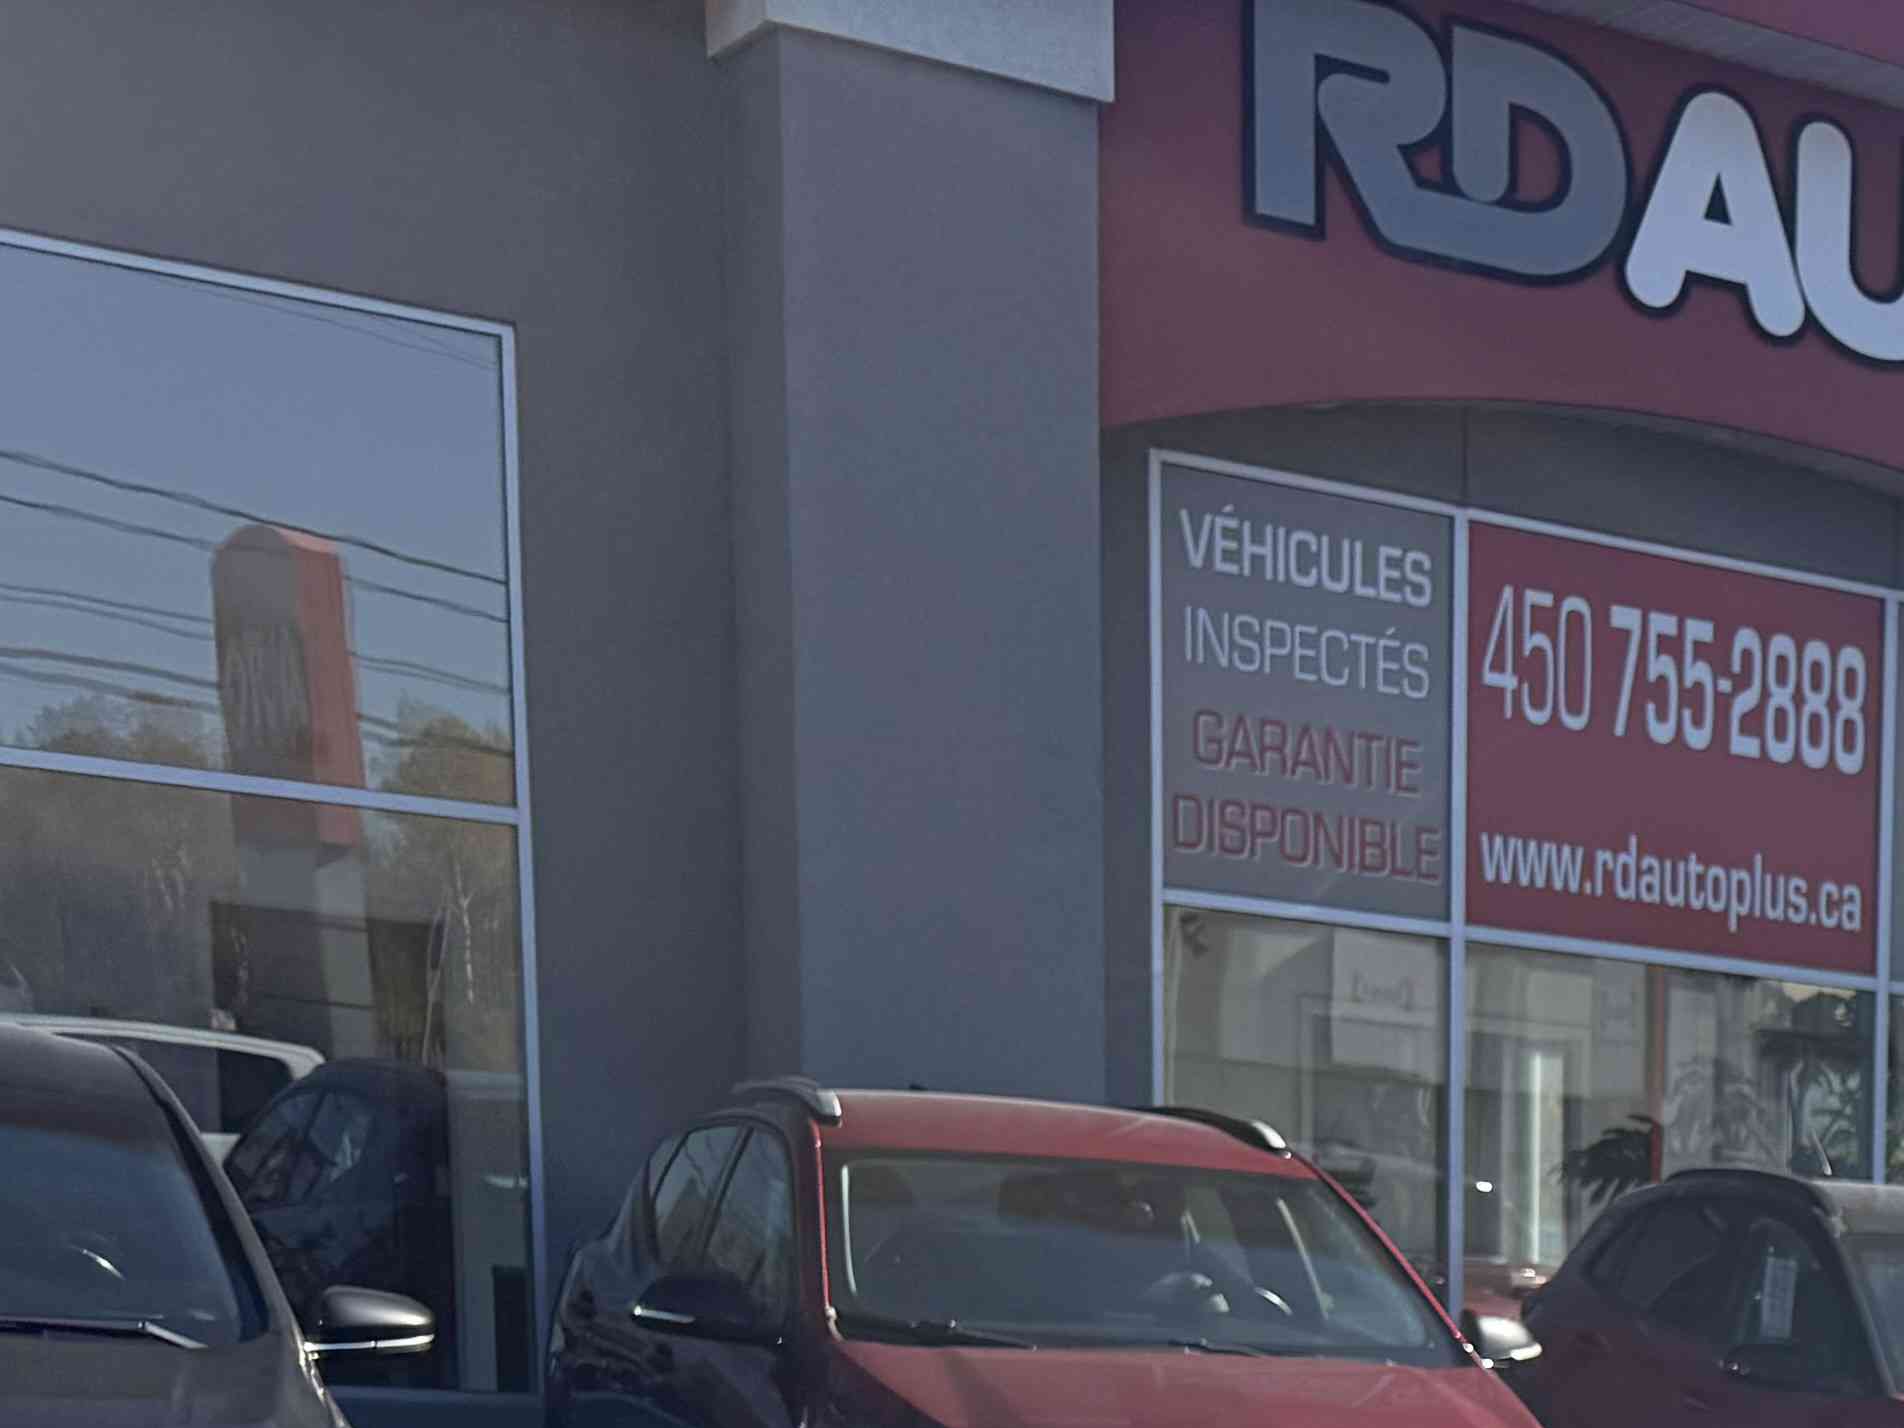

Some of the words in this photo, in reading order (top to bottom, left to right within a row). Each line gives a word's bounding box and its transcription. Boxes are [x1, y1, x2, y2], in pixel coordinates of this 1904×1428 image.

[1179, 503, 1433, 608] VÉHICULES
[1183, 605, 1431, 700] INSPECTÉS
[1481, 583, 1593, 732] 450
[1609, 603, 1867, 776] 755-2888
[1192, 708, 1423, 798] GARANTIE
[1171, 792, 1442, 884] DISPONIBLE
[1479, 831, 1863, 934] www.rdautoplus.ca
